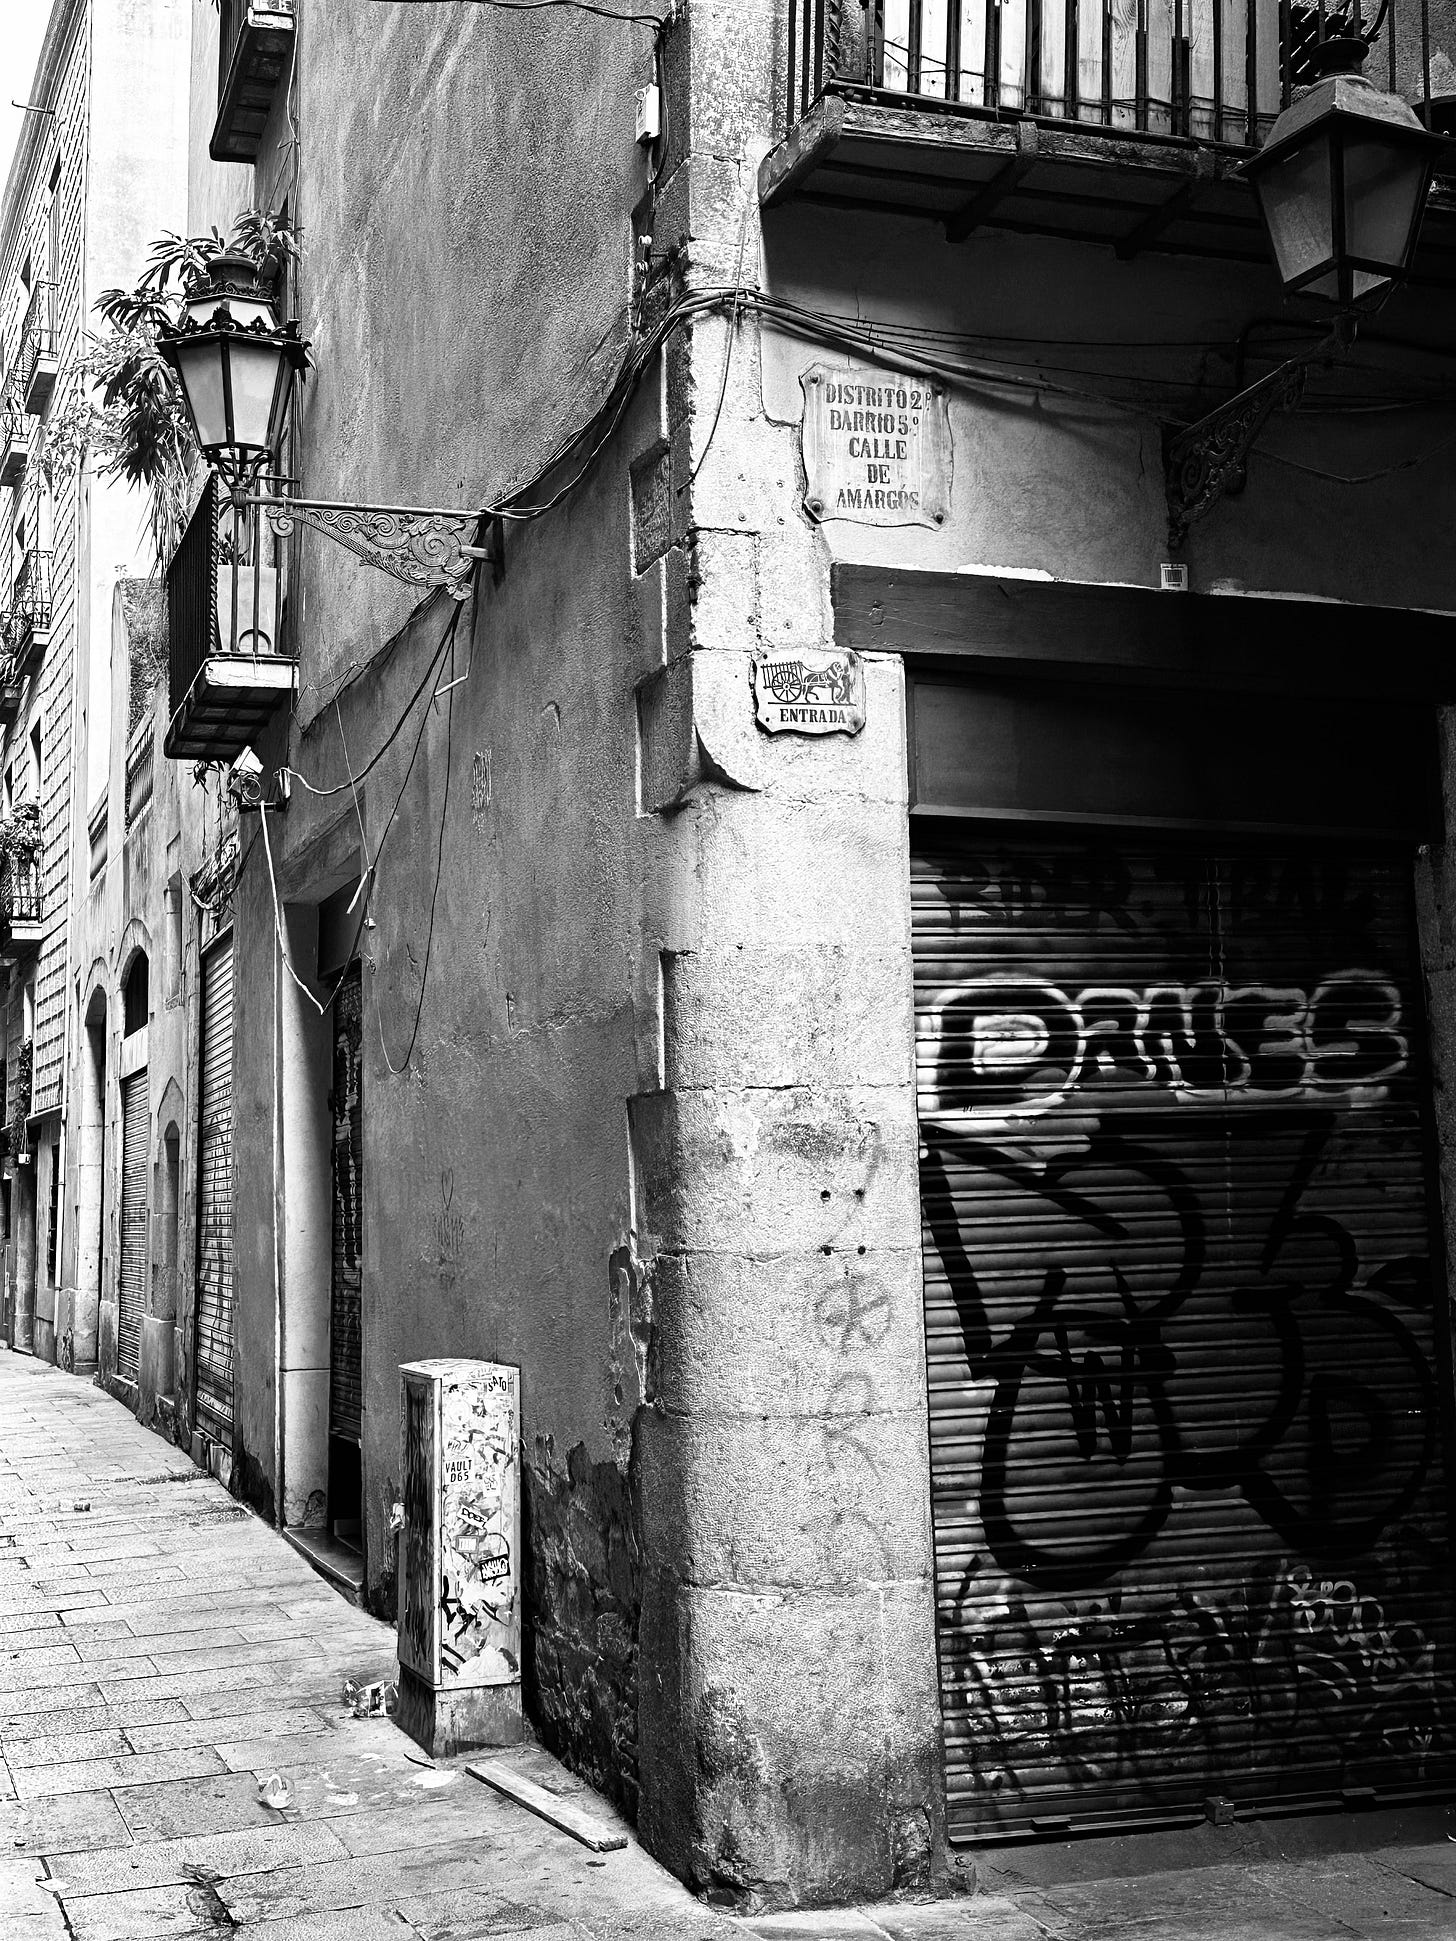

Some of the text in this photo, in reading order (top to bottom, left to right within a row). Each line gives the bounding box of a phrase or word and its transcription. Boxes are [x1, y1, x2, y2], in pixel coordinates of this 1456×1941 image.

[825, 383, 908, 409] DISTRITO
[830, 409, 896, 434] BARRIO
[849, 437, 908, 460] CALLE
[867, 463, 891, 484] DE
[779, 708, 847, 724] ENTRADA
[487, 1375, 507, 1393] SATO
[445, 1459, 473, 1474] VAULT
